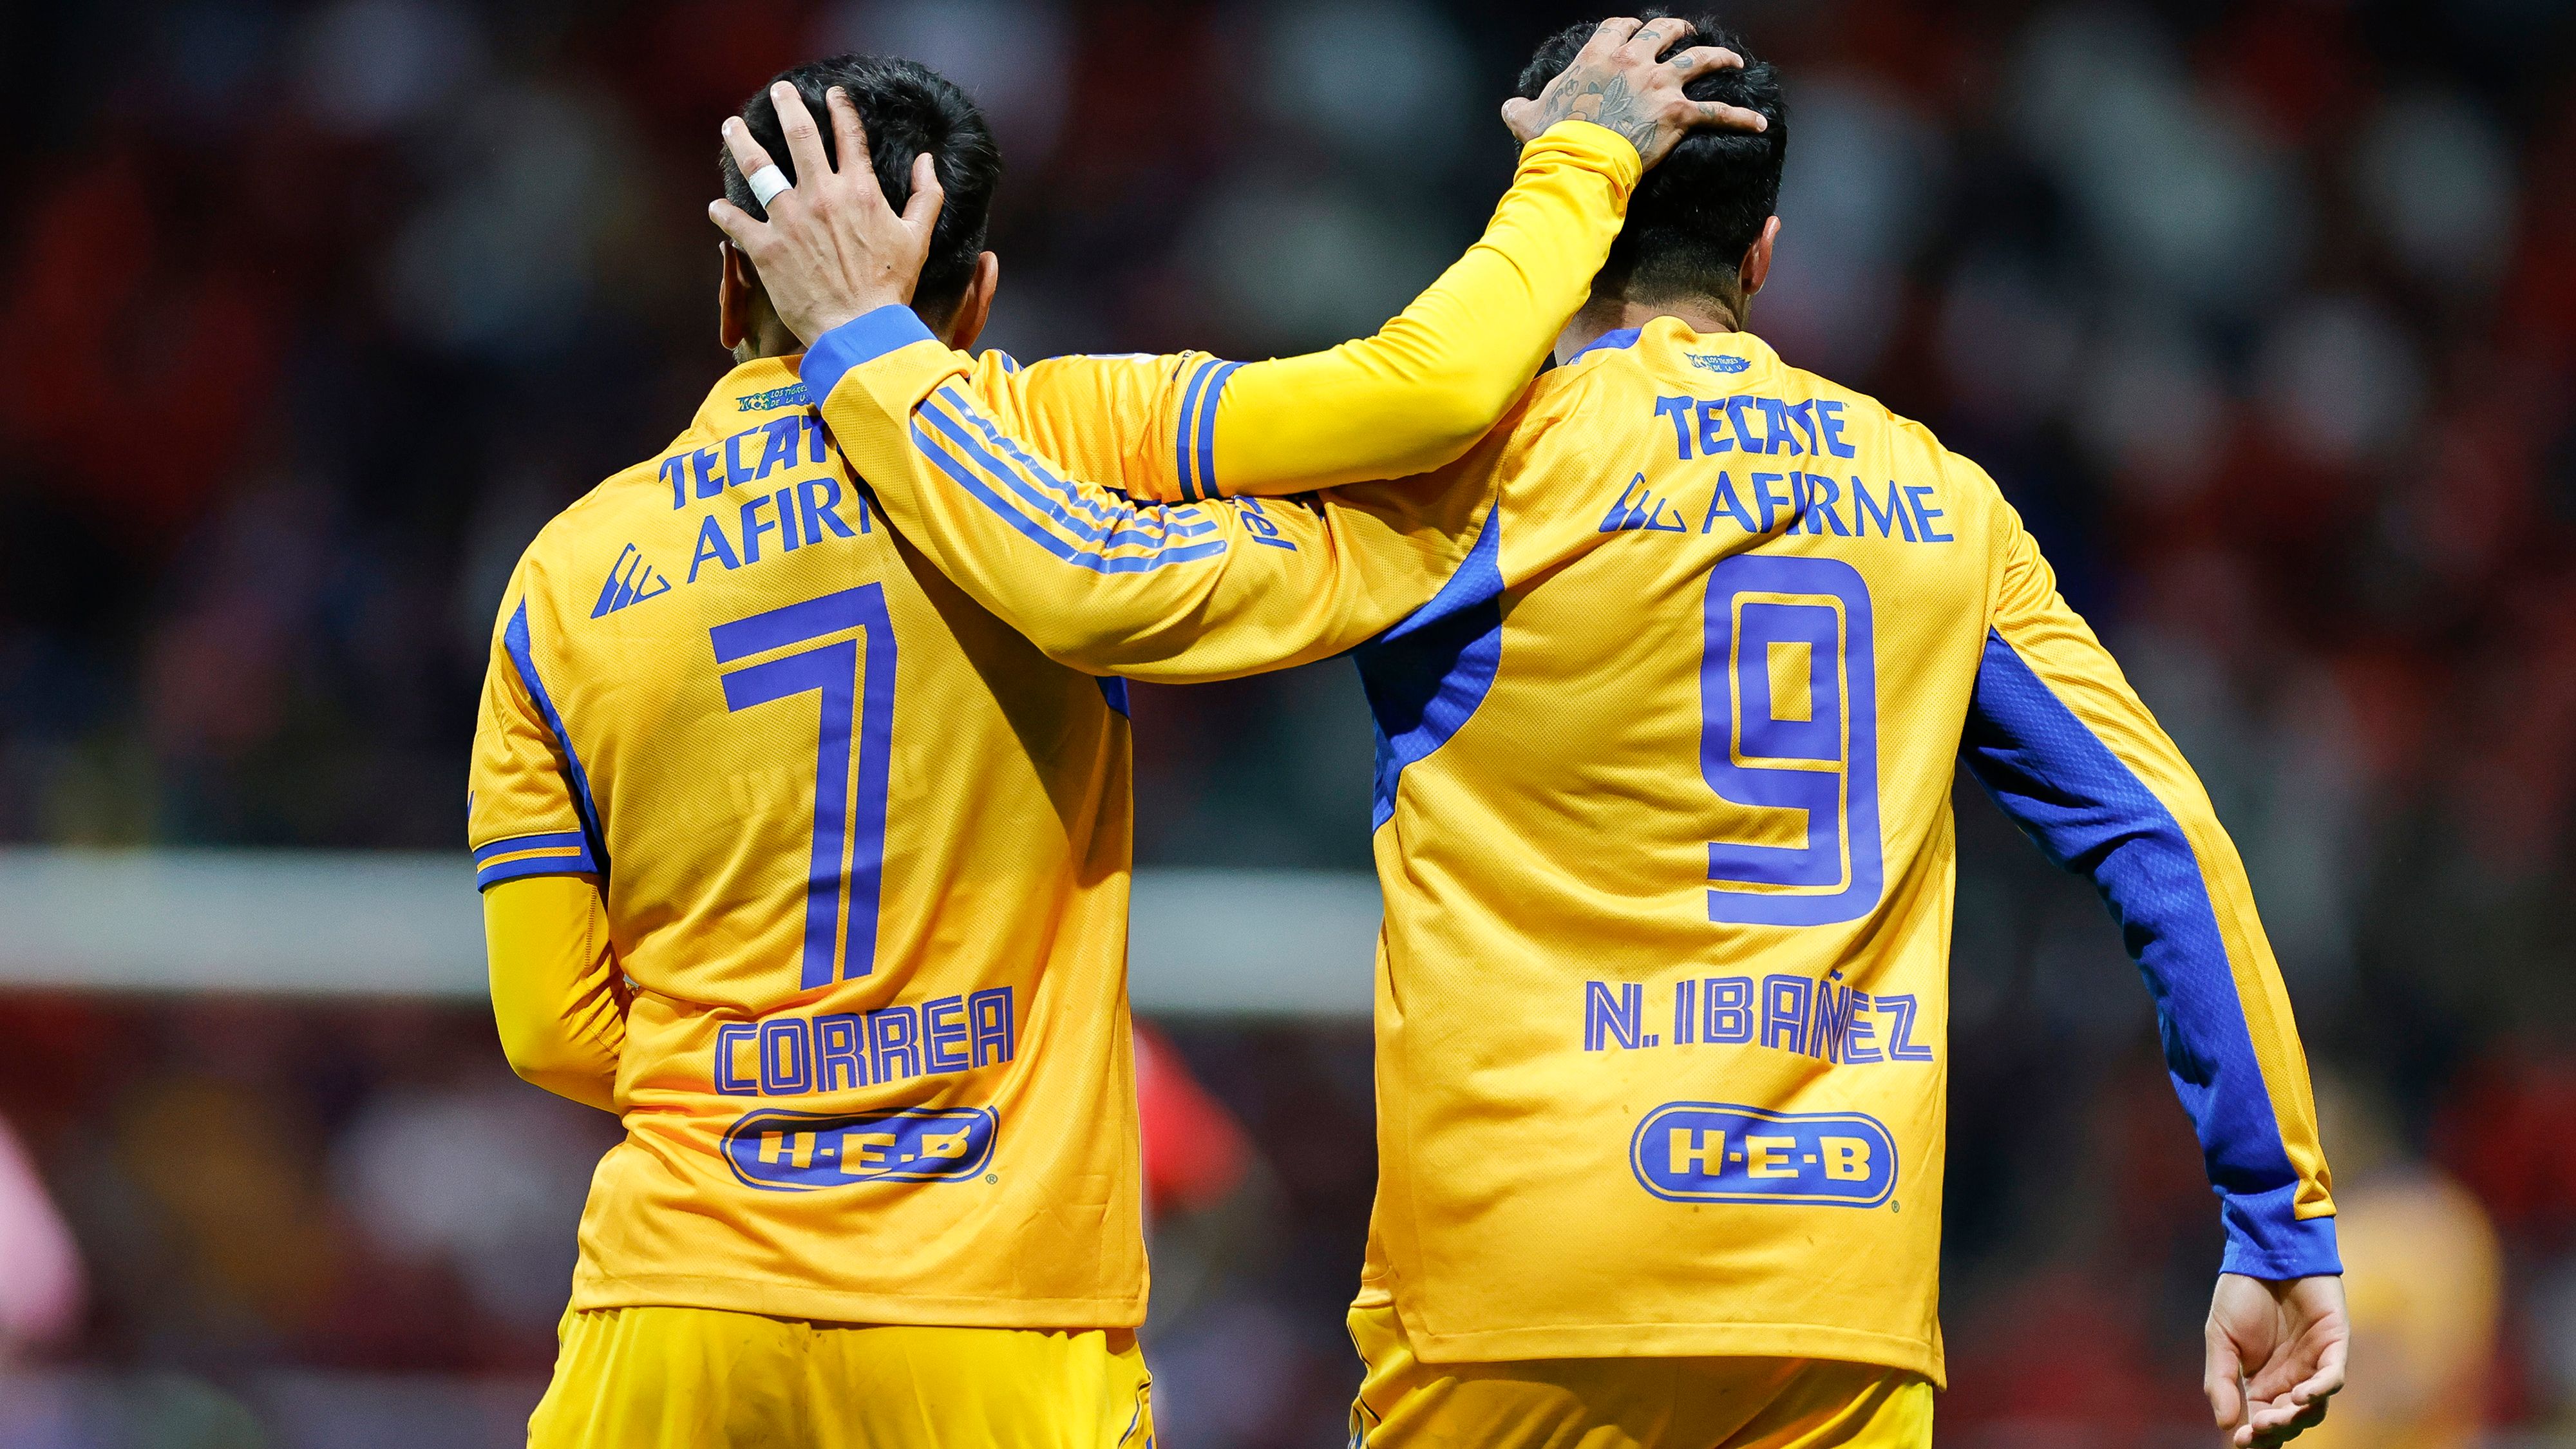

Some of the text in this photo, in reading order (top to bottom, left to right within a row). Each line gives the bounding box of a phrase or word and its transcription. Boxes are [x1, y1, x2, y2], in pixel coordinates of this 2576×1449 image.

[770, 389, 784, 399] LOS
[770, 399, 781, 407] DE
[1654, 395, 1855, 460] TECATE
[659, 415, 828, 510] TECAT
[1701, 471, 1954, 542] AFIRME
[709, 582, 898, 990] 7
[1700, 554, 1884, 926] 9
[714, 985, 1015, 1097] CORREA
[1674, 969, 1934, 1065] IBAÑEZ
